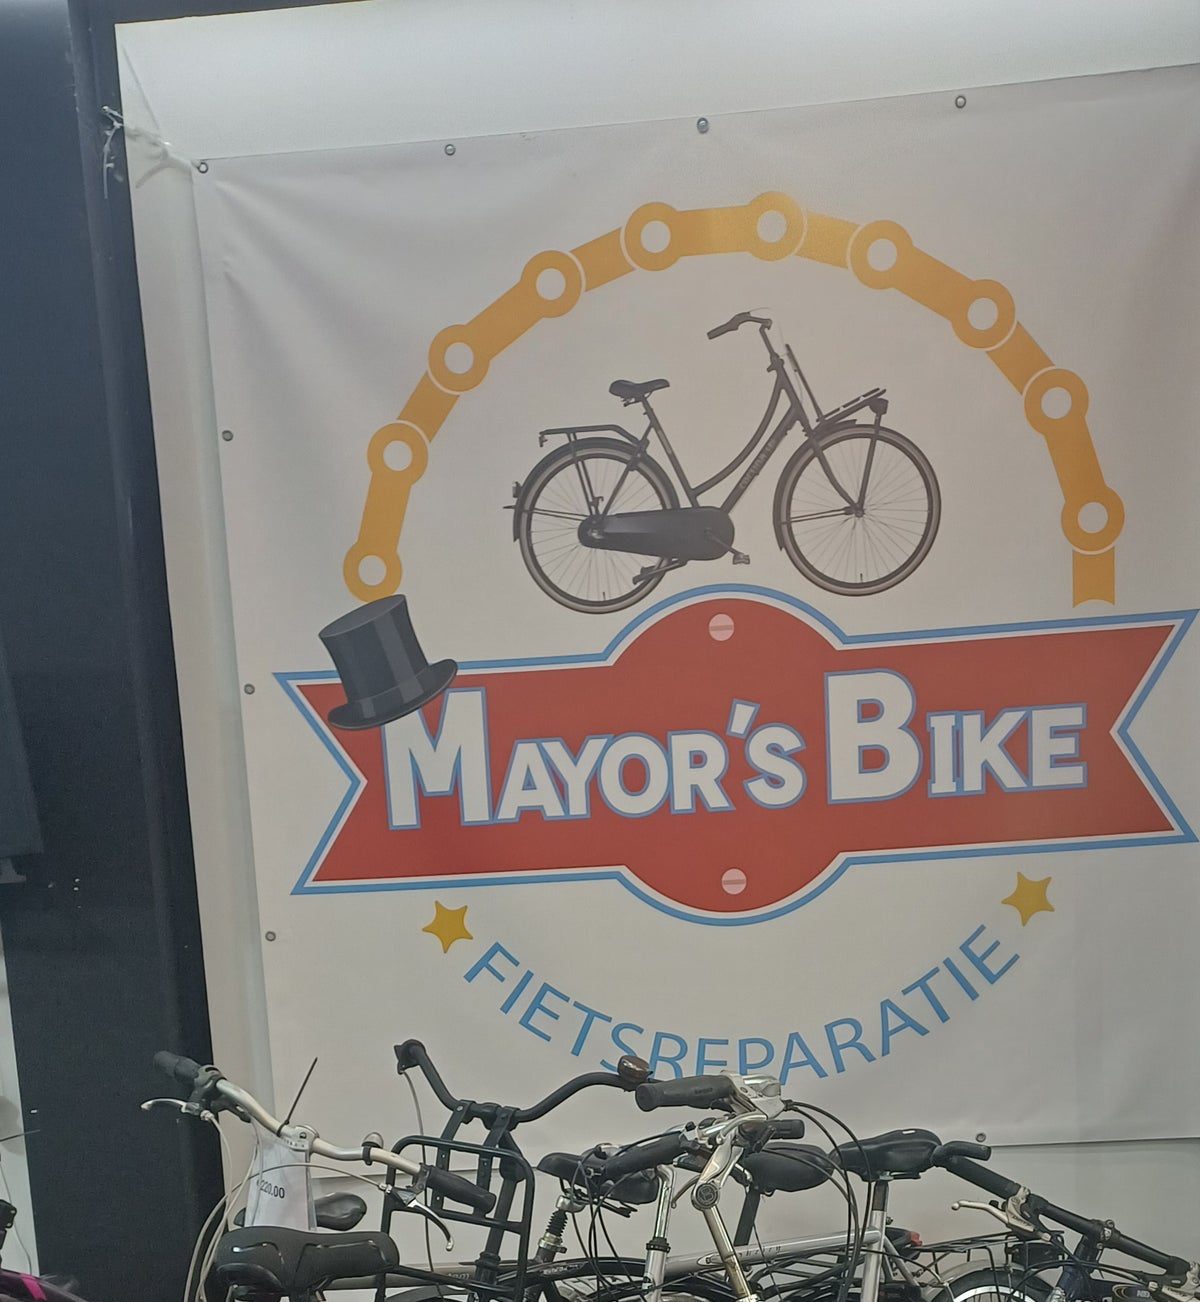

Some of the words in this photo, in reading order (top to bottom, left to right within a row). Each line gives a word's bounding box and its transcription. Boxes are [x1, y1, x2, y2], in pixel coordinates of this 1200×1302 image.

[381, 686, 807, 830] MAYOR'S
[824, 667, 1088, 805] BIKE
[463, 924, 1020, 1085] FIETSREPARATIE
